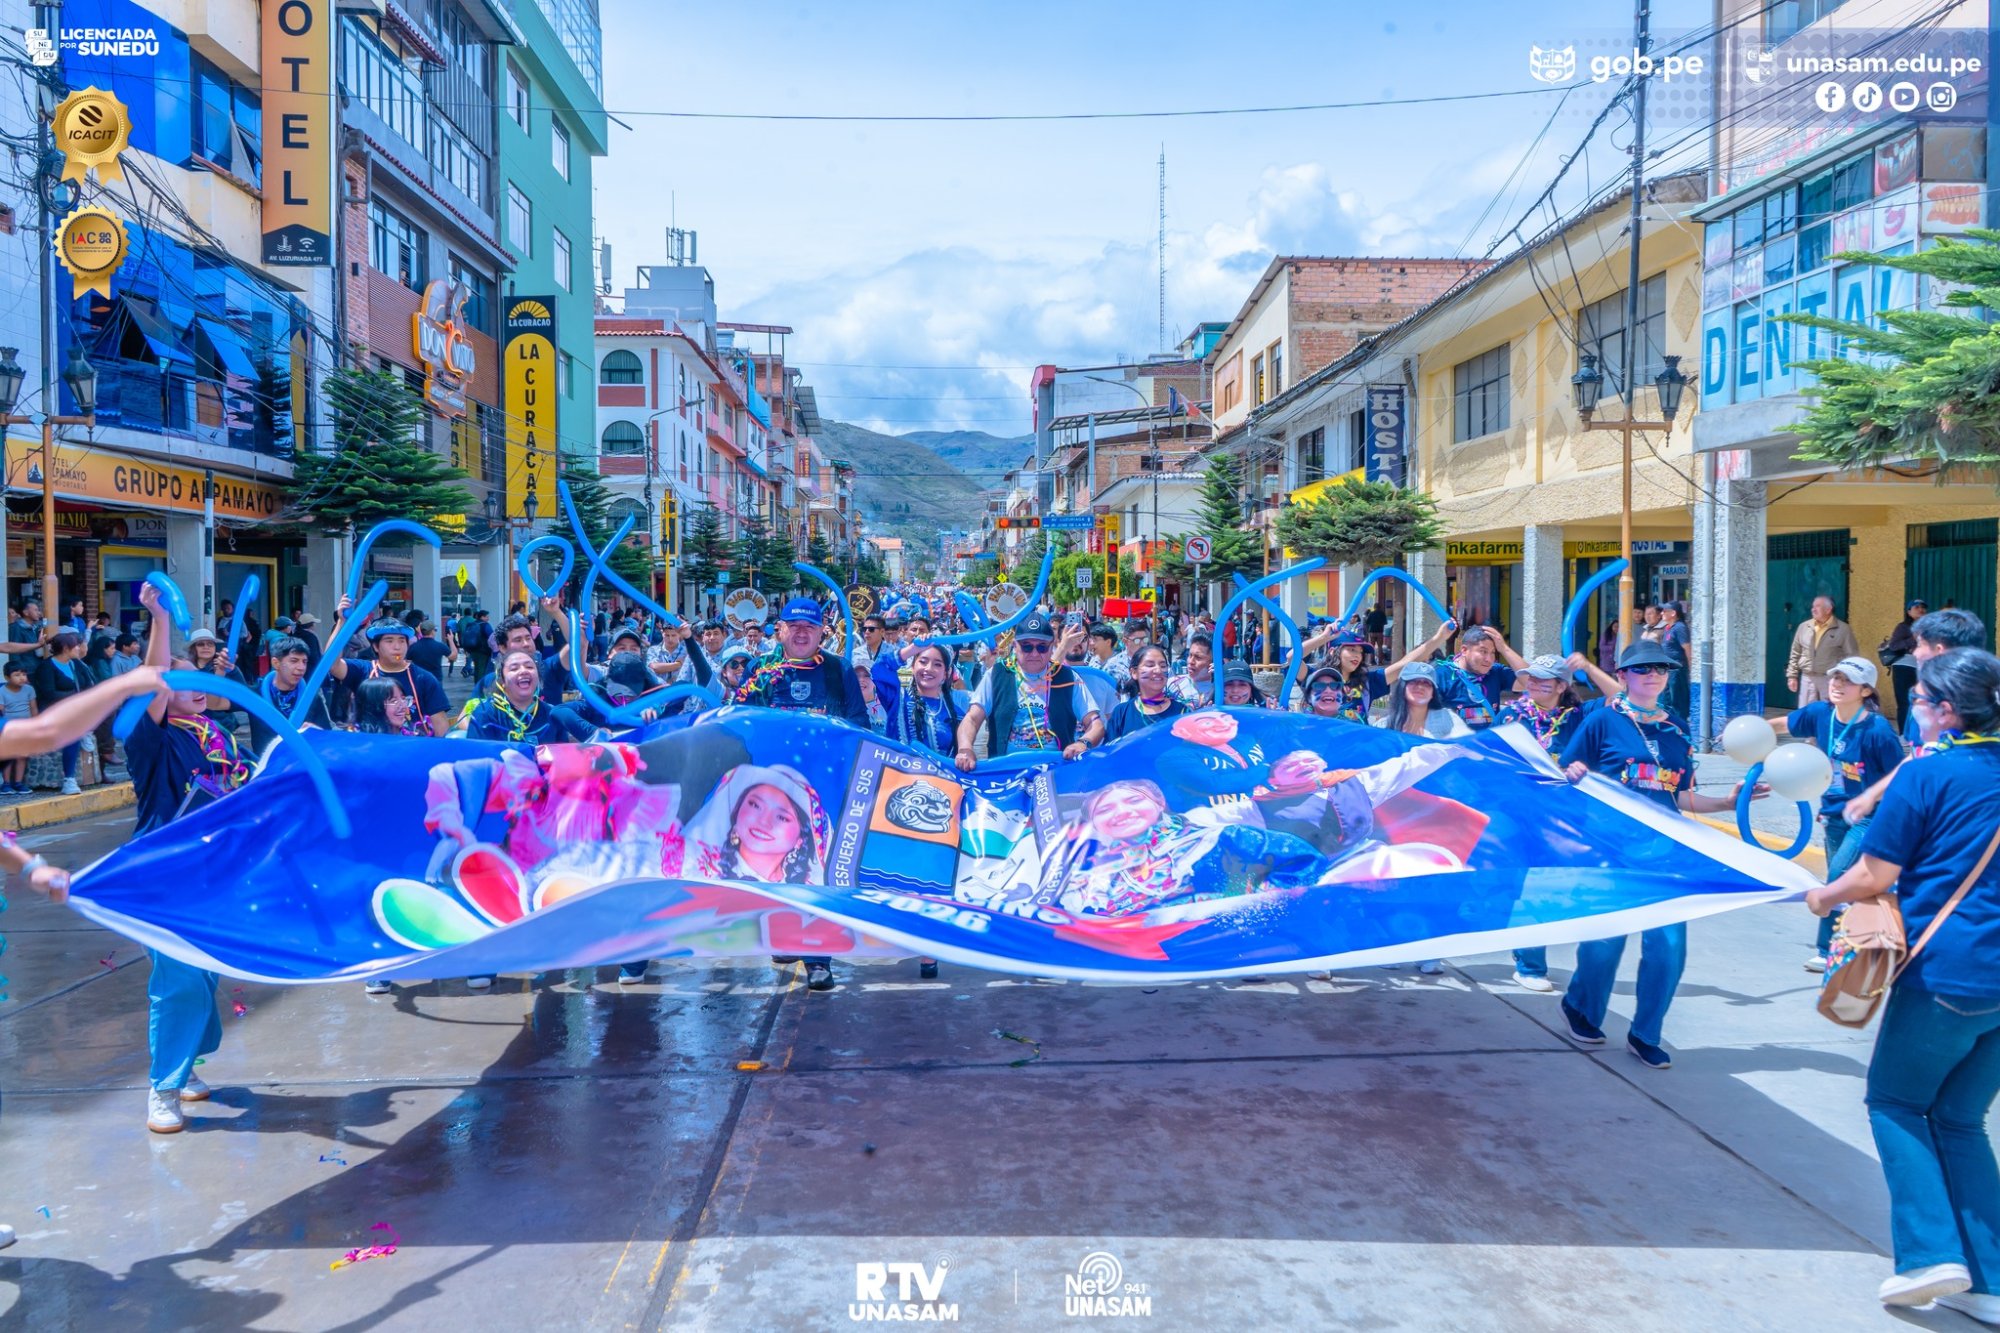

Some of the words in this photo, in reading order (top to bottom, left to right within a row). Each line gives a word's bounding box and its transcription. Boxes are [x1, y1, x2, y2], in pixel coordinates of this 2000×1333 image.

[509, 318, 518, 327] LA
[519, 318, 551, 327] CURACAO
[421, 323, 447, 358] DON
[520, 344, 540, 360] LA
[525, 368, 537, 490] CURACA
[1371, 394, 1400, 490] HOSTA
[115, 466, 182, 500] GRUPO
[135, 518, 167, 531] DON
[1079, 575, 1090, 583] 30
[1662, 566, 1687, 575] PARAISO
[873, 748, 922, 771] HIJOS
[856, 768, 874, 795] SUS
[849, 800, 865, 818] DE
[1040, 807, 1054, 825] DE
[835, 823, 860, 888] ESFUERZO
[851, 889, 992, 932] 2026
